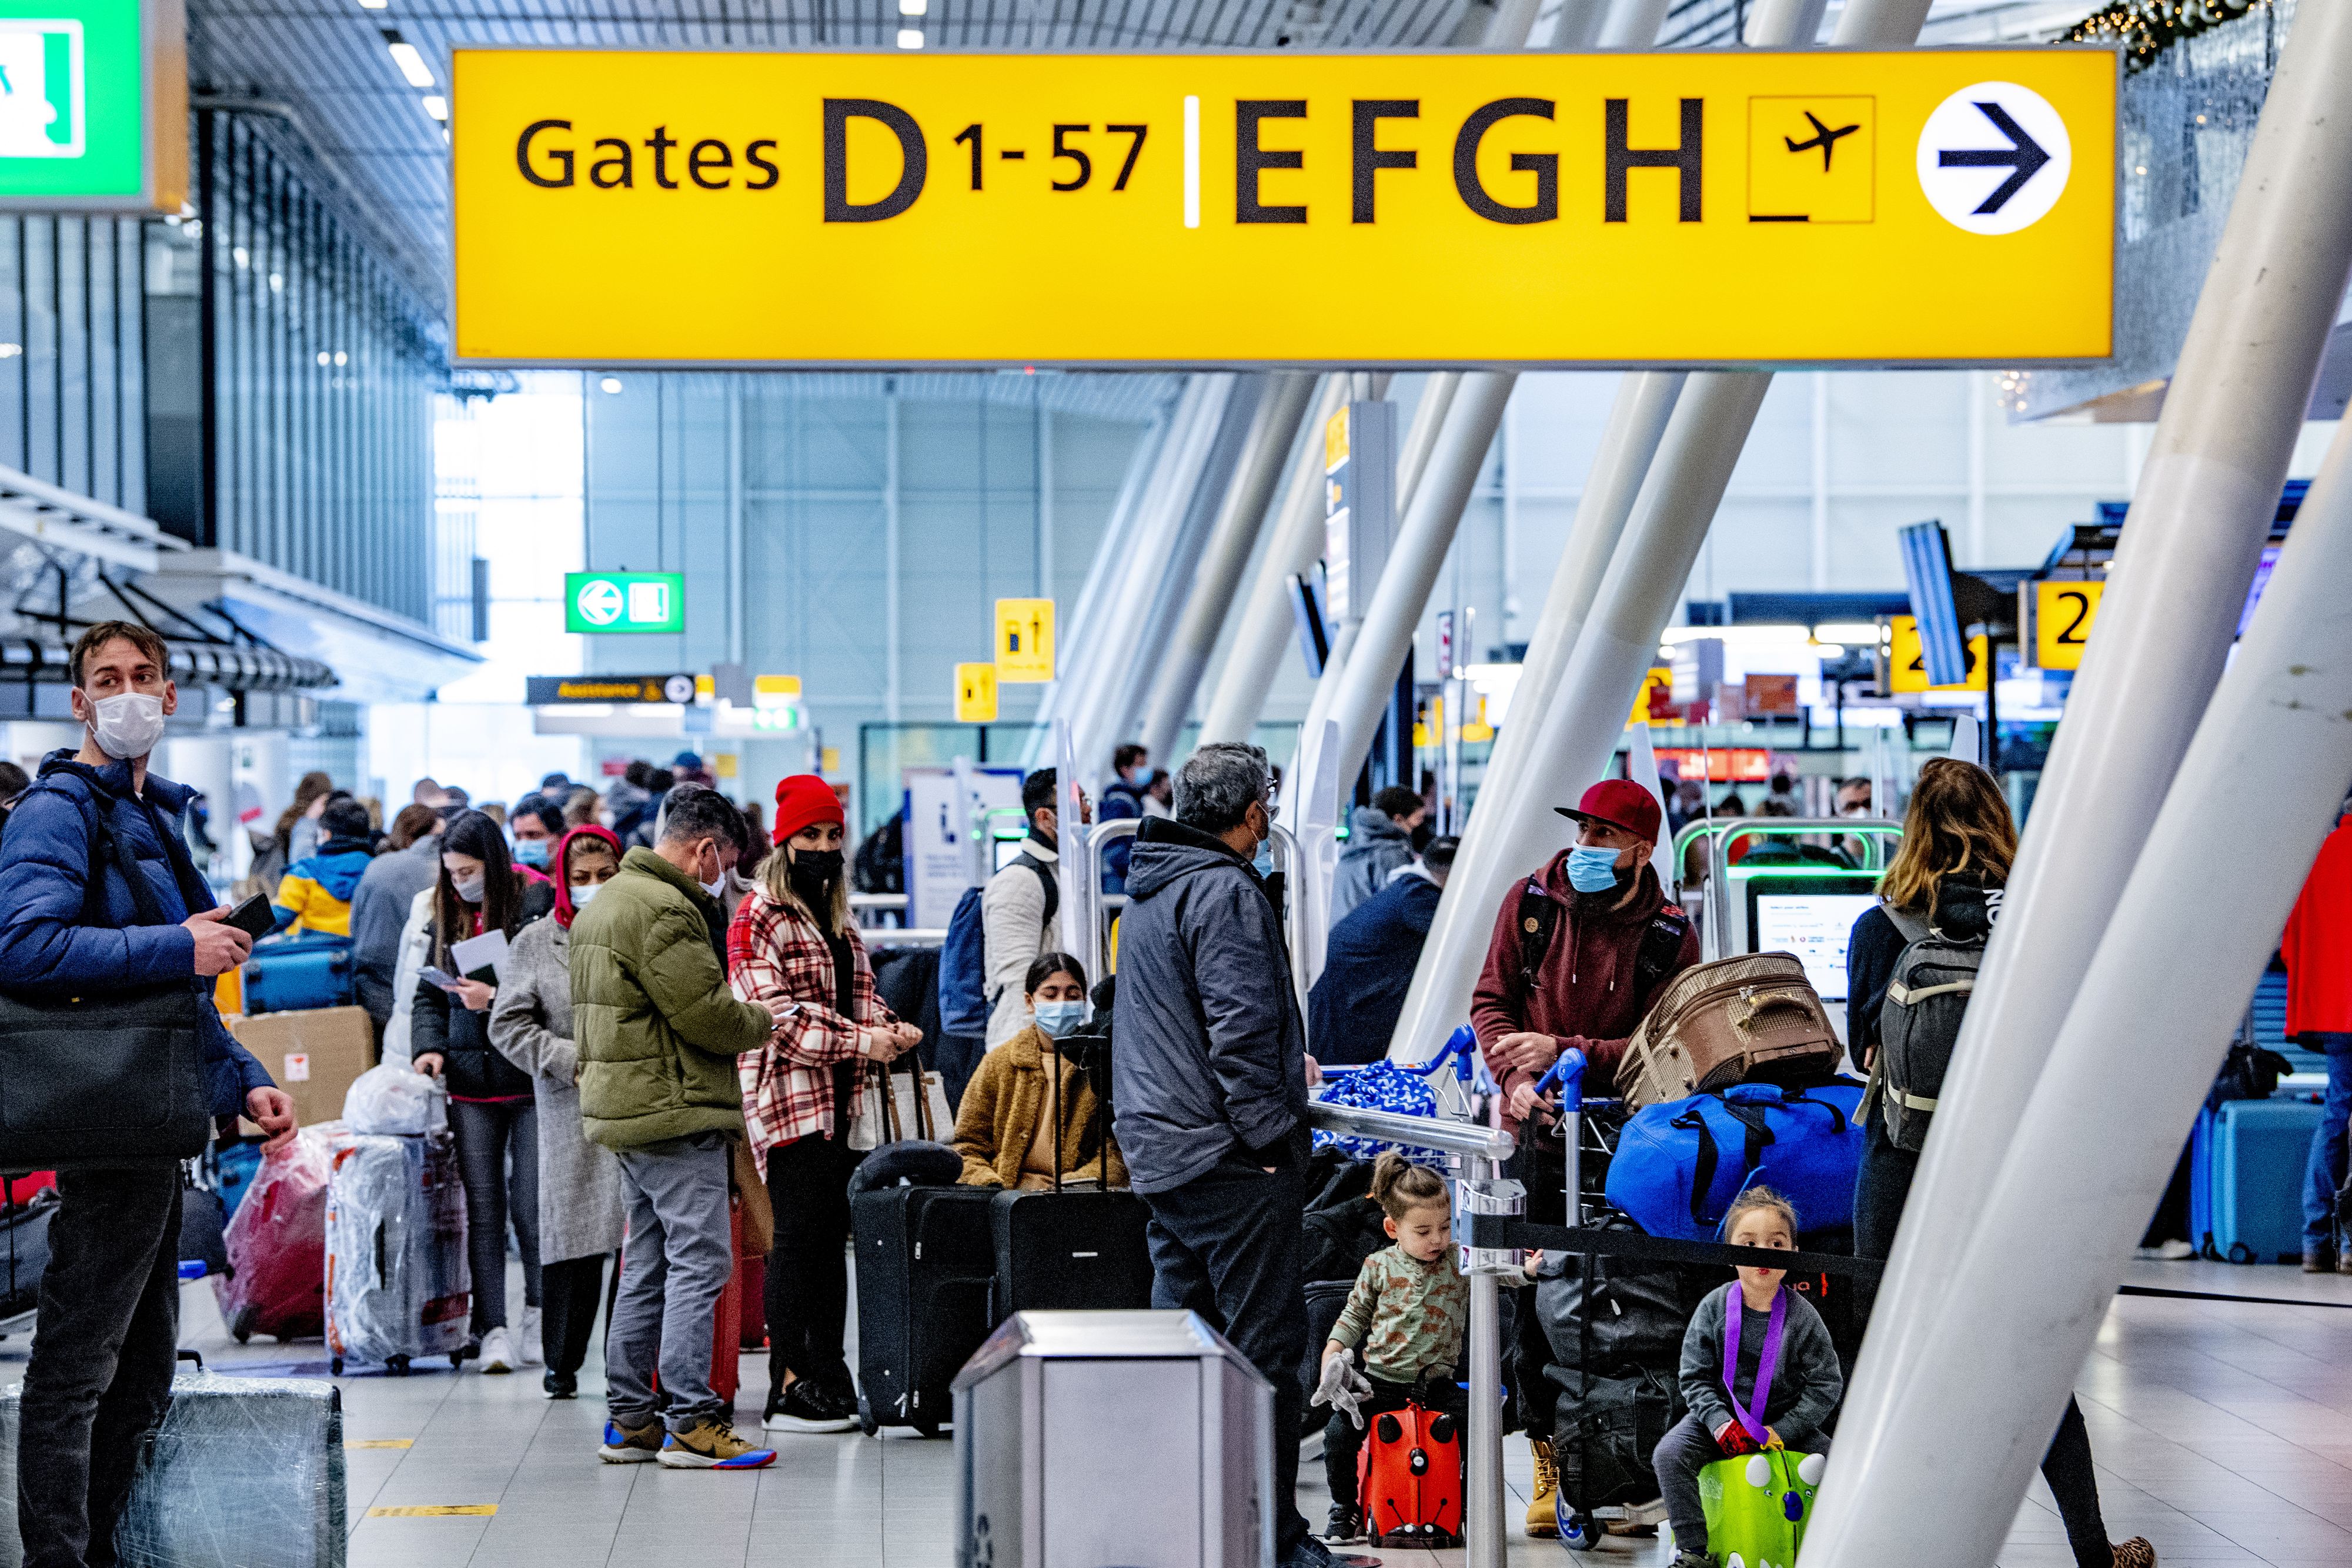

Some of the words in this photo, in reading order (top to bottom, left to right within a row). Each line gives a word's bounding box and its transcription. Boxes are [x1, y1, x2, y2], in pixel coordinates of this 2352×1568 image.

[517, 119, 779, 190] Gates
[823, 98, 927, 223] D
[1235, 99, 1308, 224] E
[1352, 99, 1420, 224] F
[1453, 97, 1559, 225] G
[1605, 98, 1703, 223] H
[2057, 591, 2103, 643] 2
